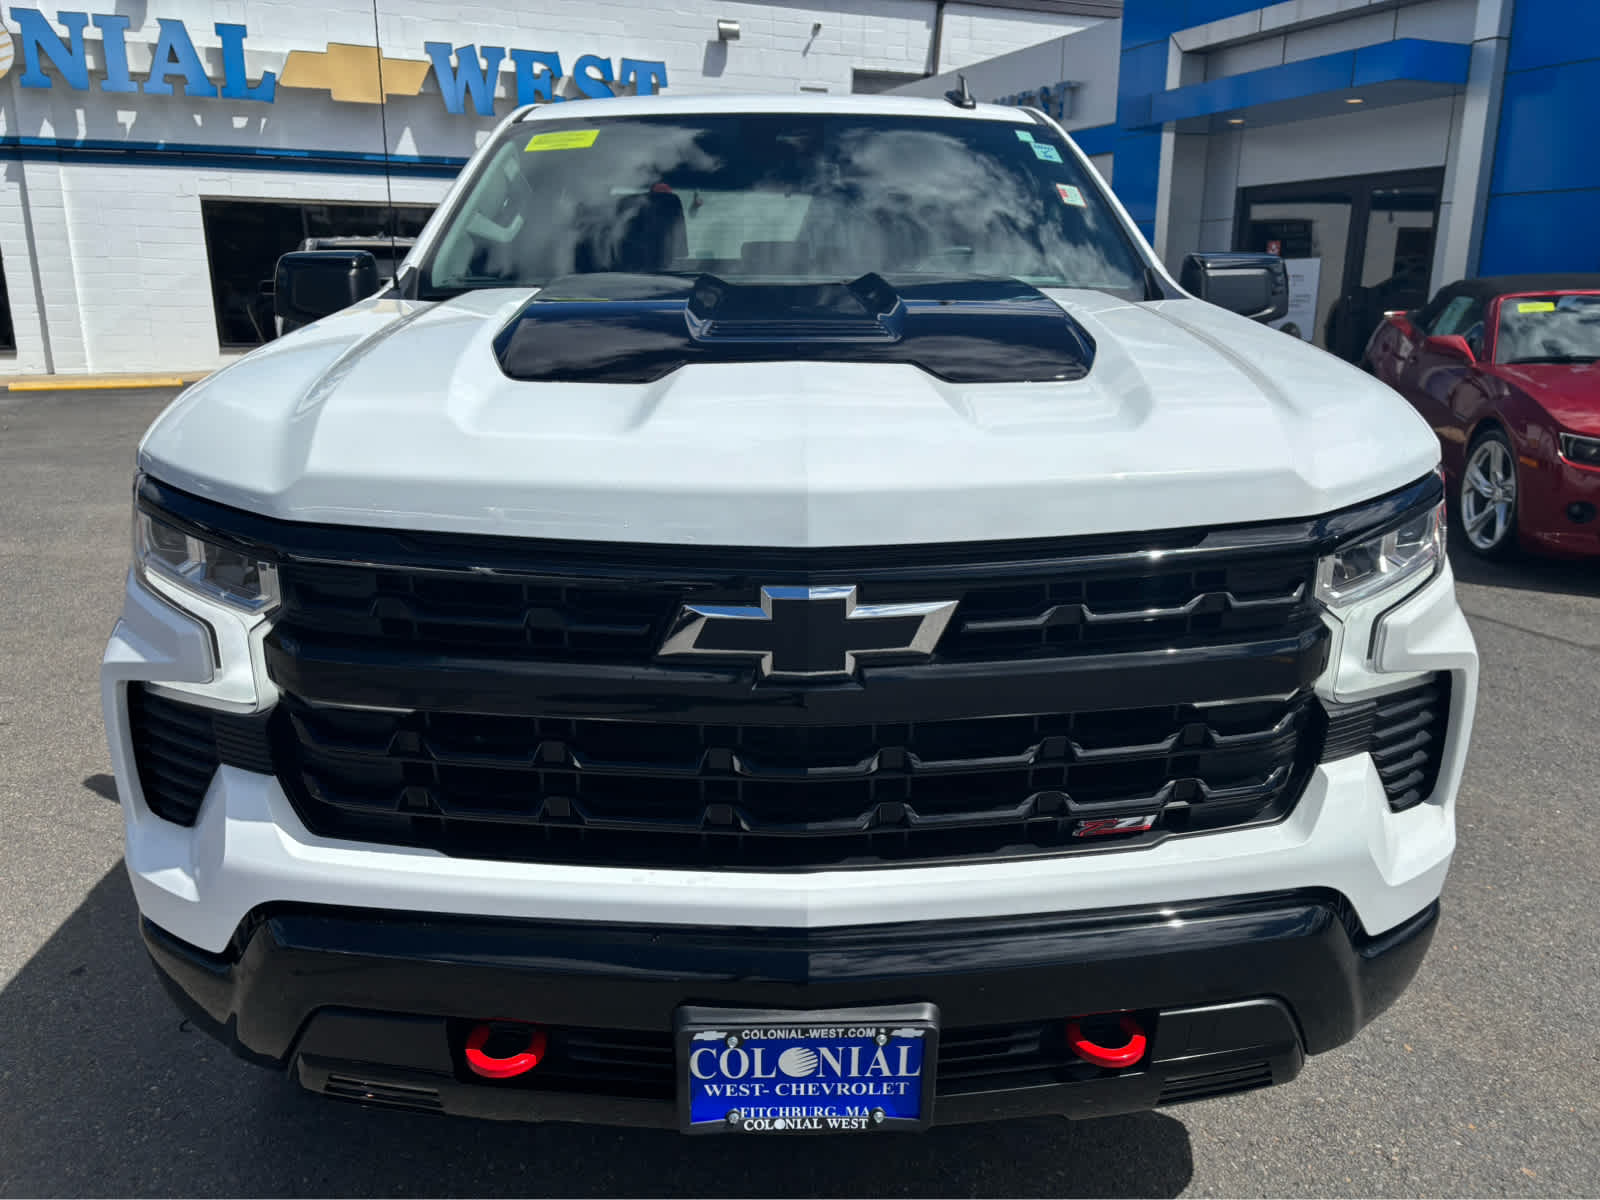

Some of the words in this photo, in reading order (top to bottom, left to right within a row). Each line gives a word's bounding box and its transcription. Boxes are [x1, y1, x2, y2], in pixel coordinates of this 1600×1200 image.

[0, 7, 276, 104] NIAL
[424, 41, 668, 116] WEST
[742, 1028, 876, 1039] COLONIAL-WEST.COM
[690, 1046, 921, 1079] COLONIAL
[775, 1082, 909, 1096] CHEVROLET
[846, 1106, 870, 1117] MA
[744, 1118, 822, 1131] COLONIAL
[826, 1118, 869, 1129] WEST
